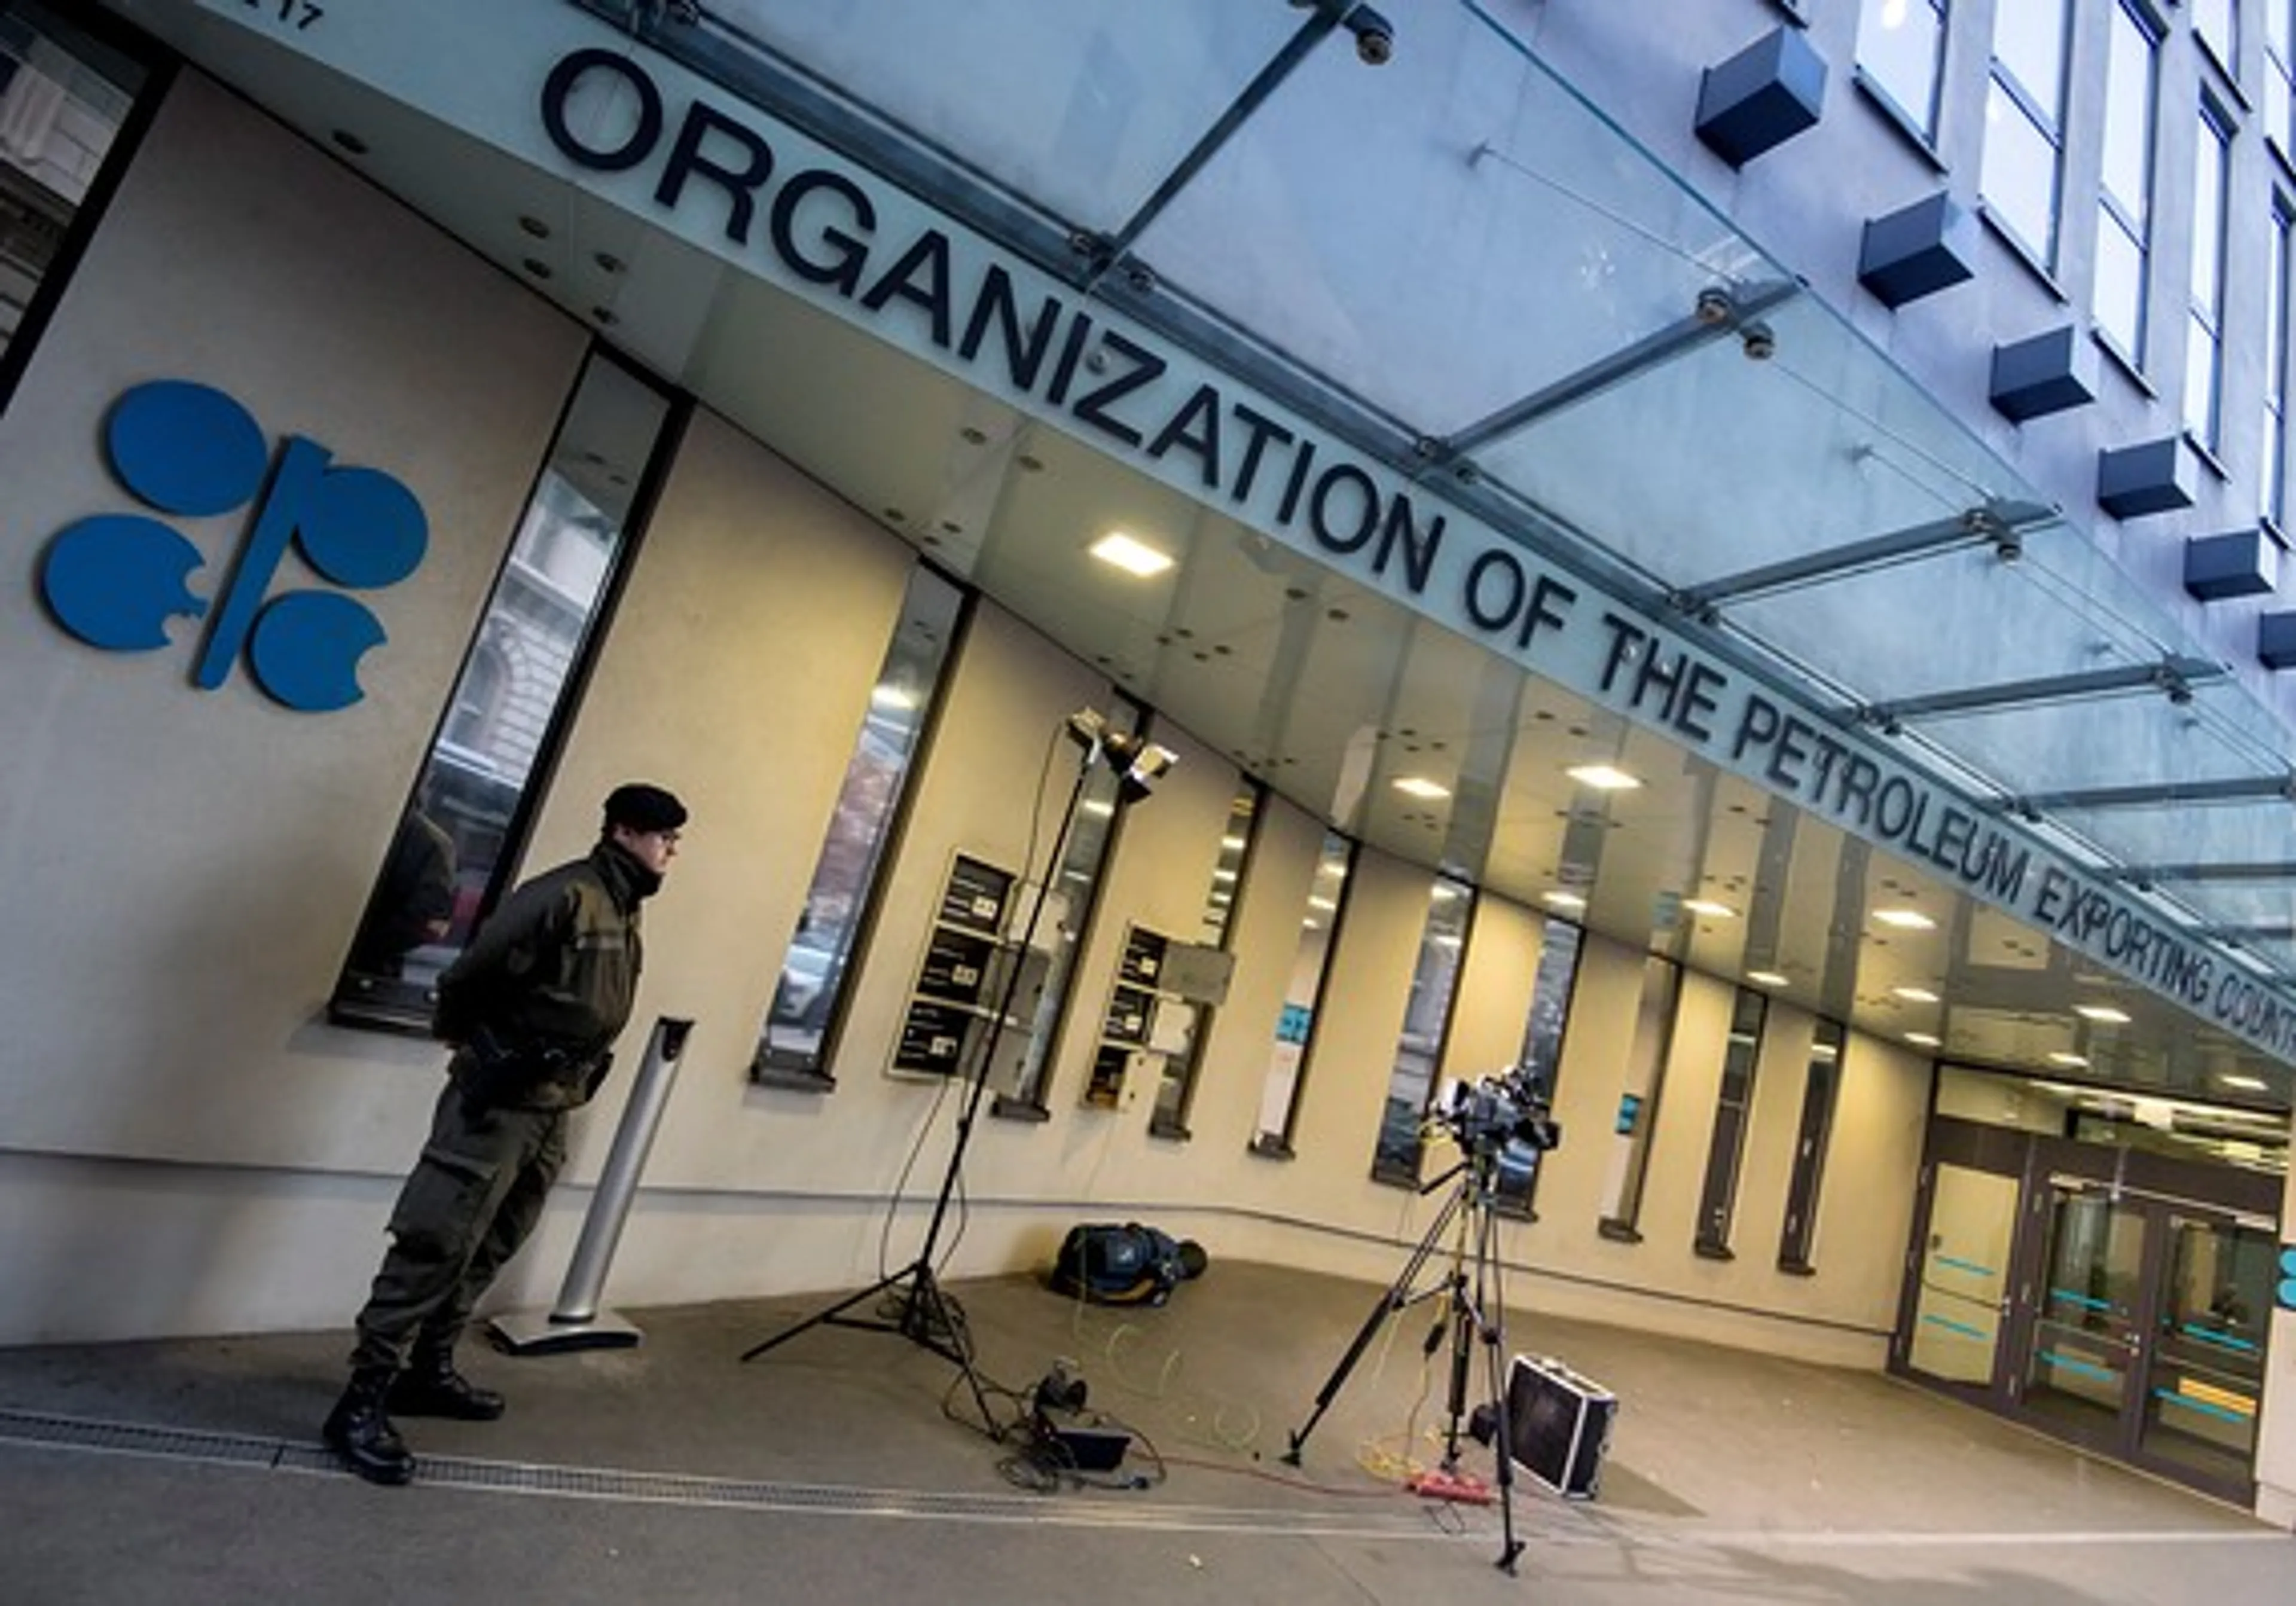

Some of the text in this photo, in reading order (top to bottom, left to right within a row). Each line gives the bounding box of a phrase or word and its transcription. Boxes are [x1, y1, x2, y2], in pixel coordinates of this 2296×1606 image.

[279, 0, 323, 30] 17
[541, 48, 1445, 594] ORGANIZATION
[1465, 548, 1577, 649] OF
[1600, 613, 1726, 742] THE
[1732, 694, 2029, 904] PETROLEUM
[2034, 866, 2212, 1002] EXPORTING
